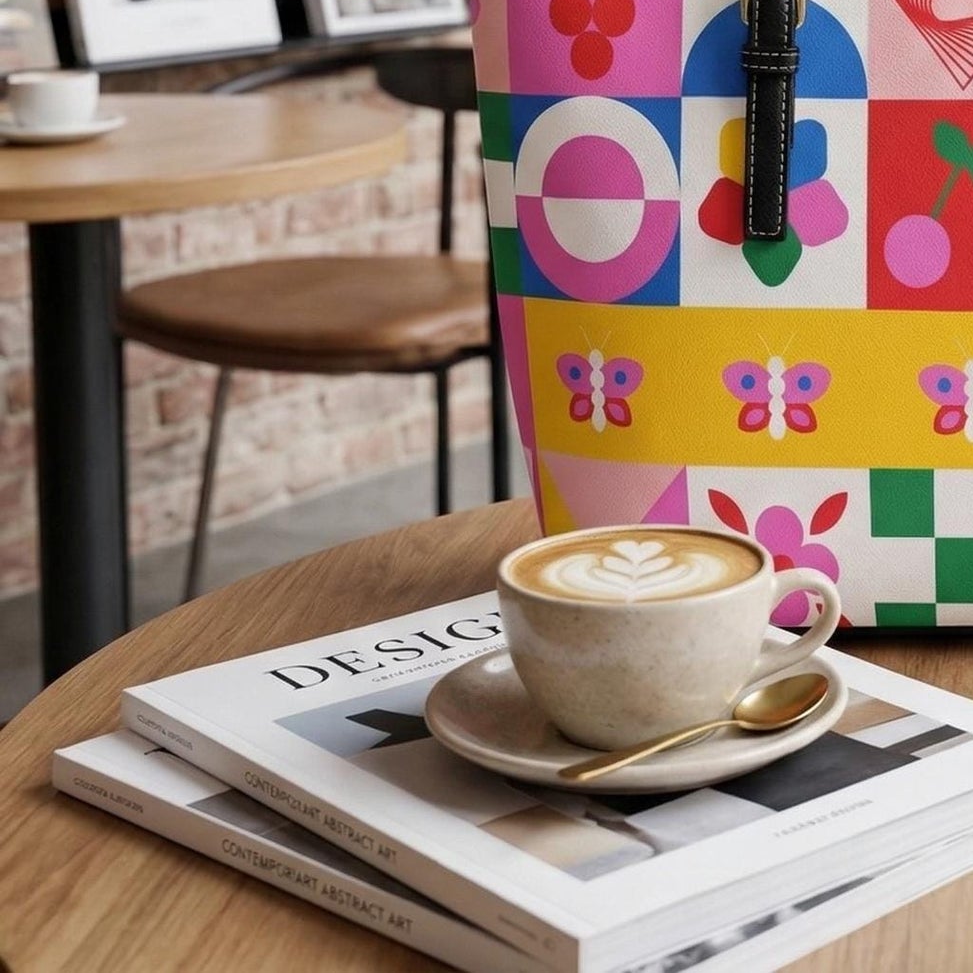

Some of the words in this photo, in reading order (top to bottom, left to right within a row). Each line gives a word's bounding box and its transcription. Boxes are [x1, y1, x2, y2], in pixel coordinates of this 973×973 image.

[263, 611, 503, 691] DESIG
[320, 884, 385, 924] ABSTRACT
[387, 912, 414, 933] ART
